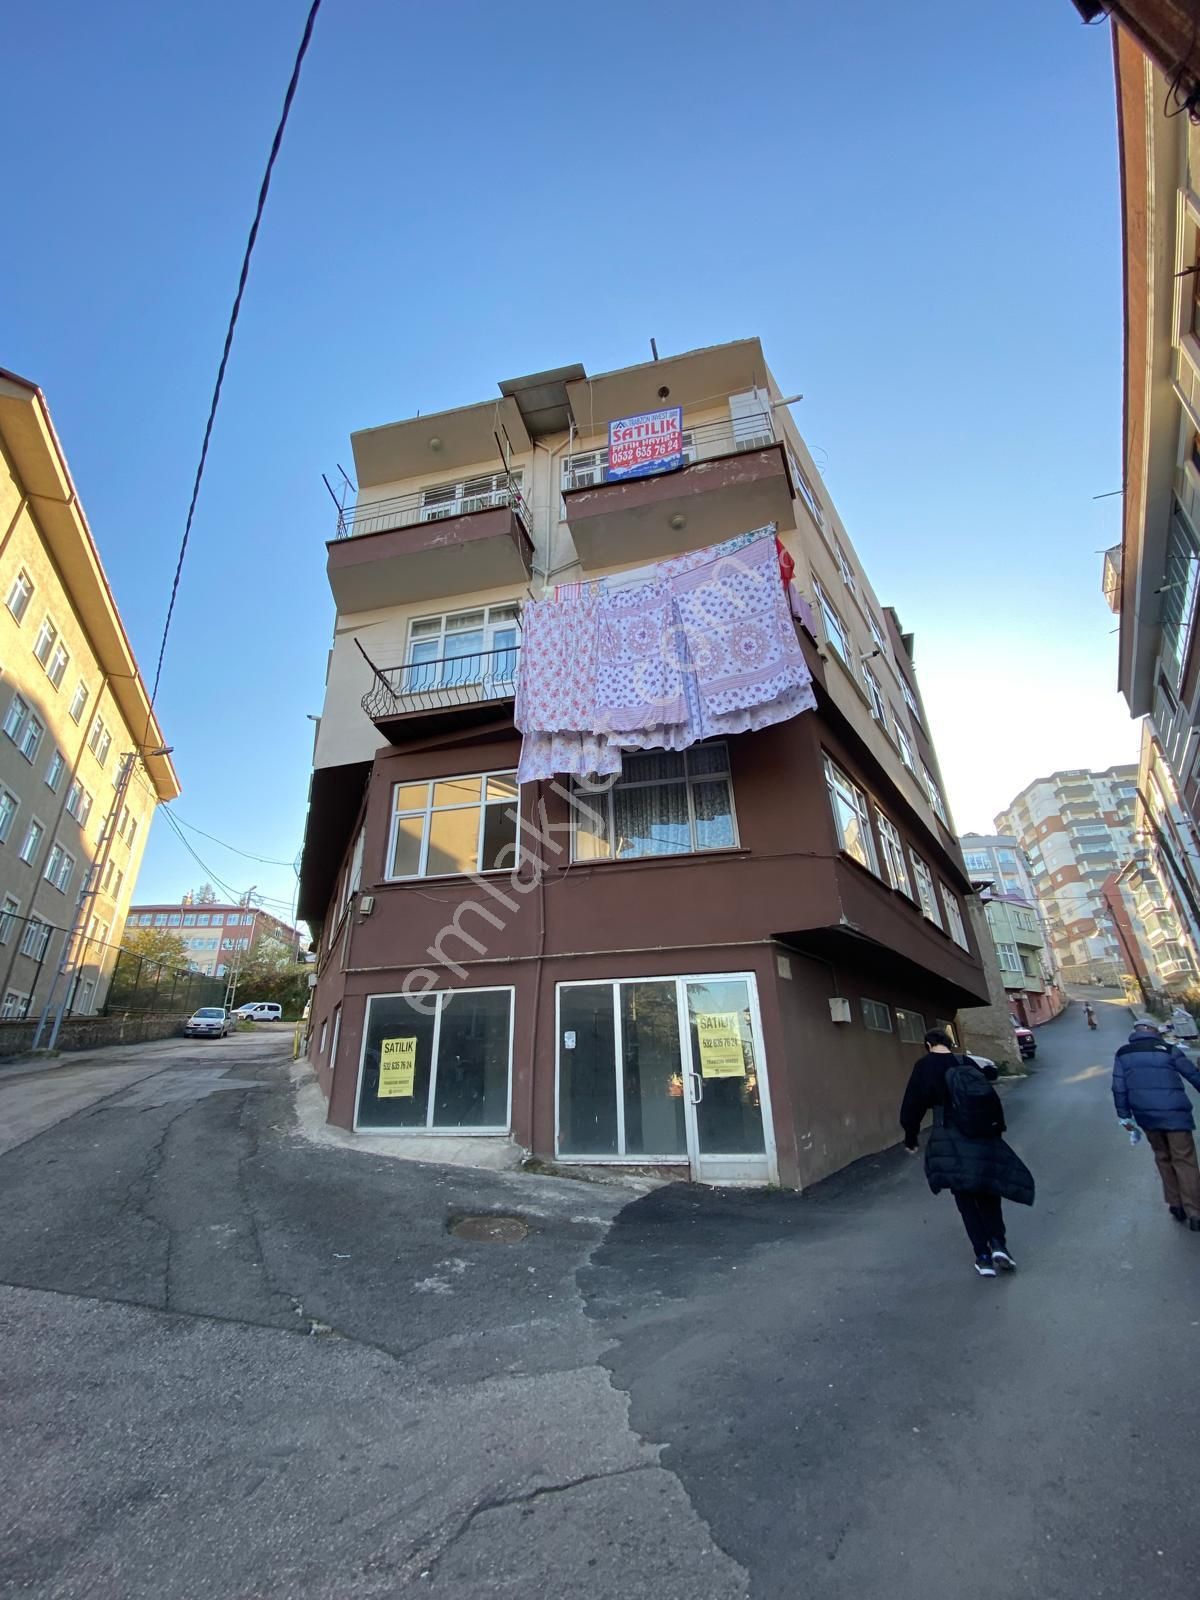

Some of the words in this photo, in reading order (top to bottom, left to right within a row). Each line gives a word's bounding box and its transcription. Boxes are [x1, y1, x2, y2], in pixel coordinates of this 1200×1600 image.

[613, 417, 677, 442] SATILIK
[612, 450, 633, 464] 0532
[636, 446, 652, 458] 635
[654, 444, 666, 455] 76
[668, 439, 678, 451] 24
[700, 1015, 735, 1029] SATILIK
[384, 1041, 413, 1053] SATILIK
